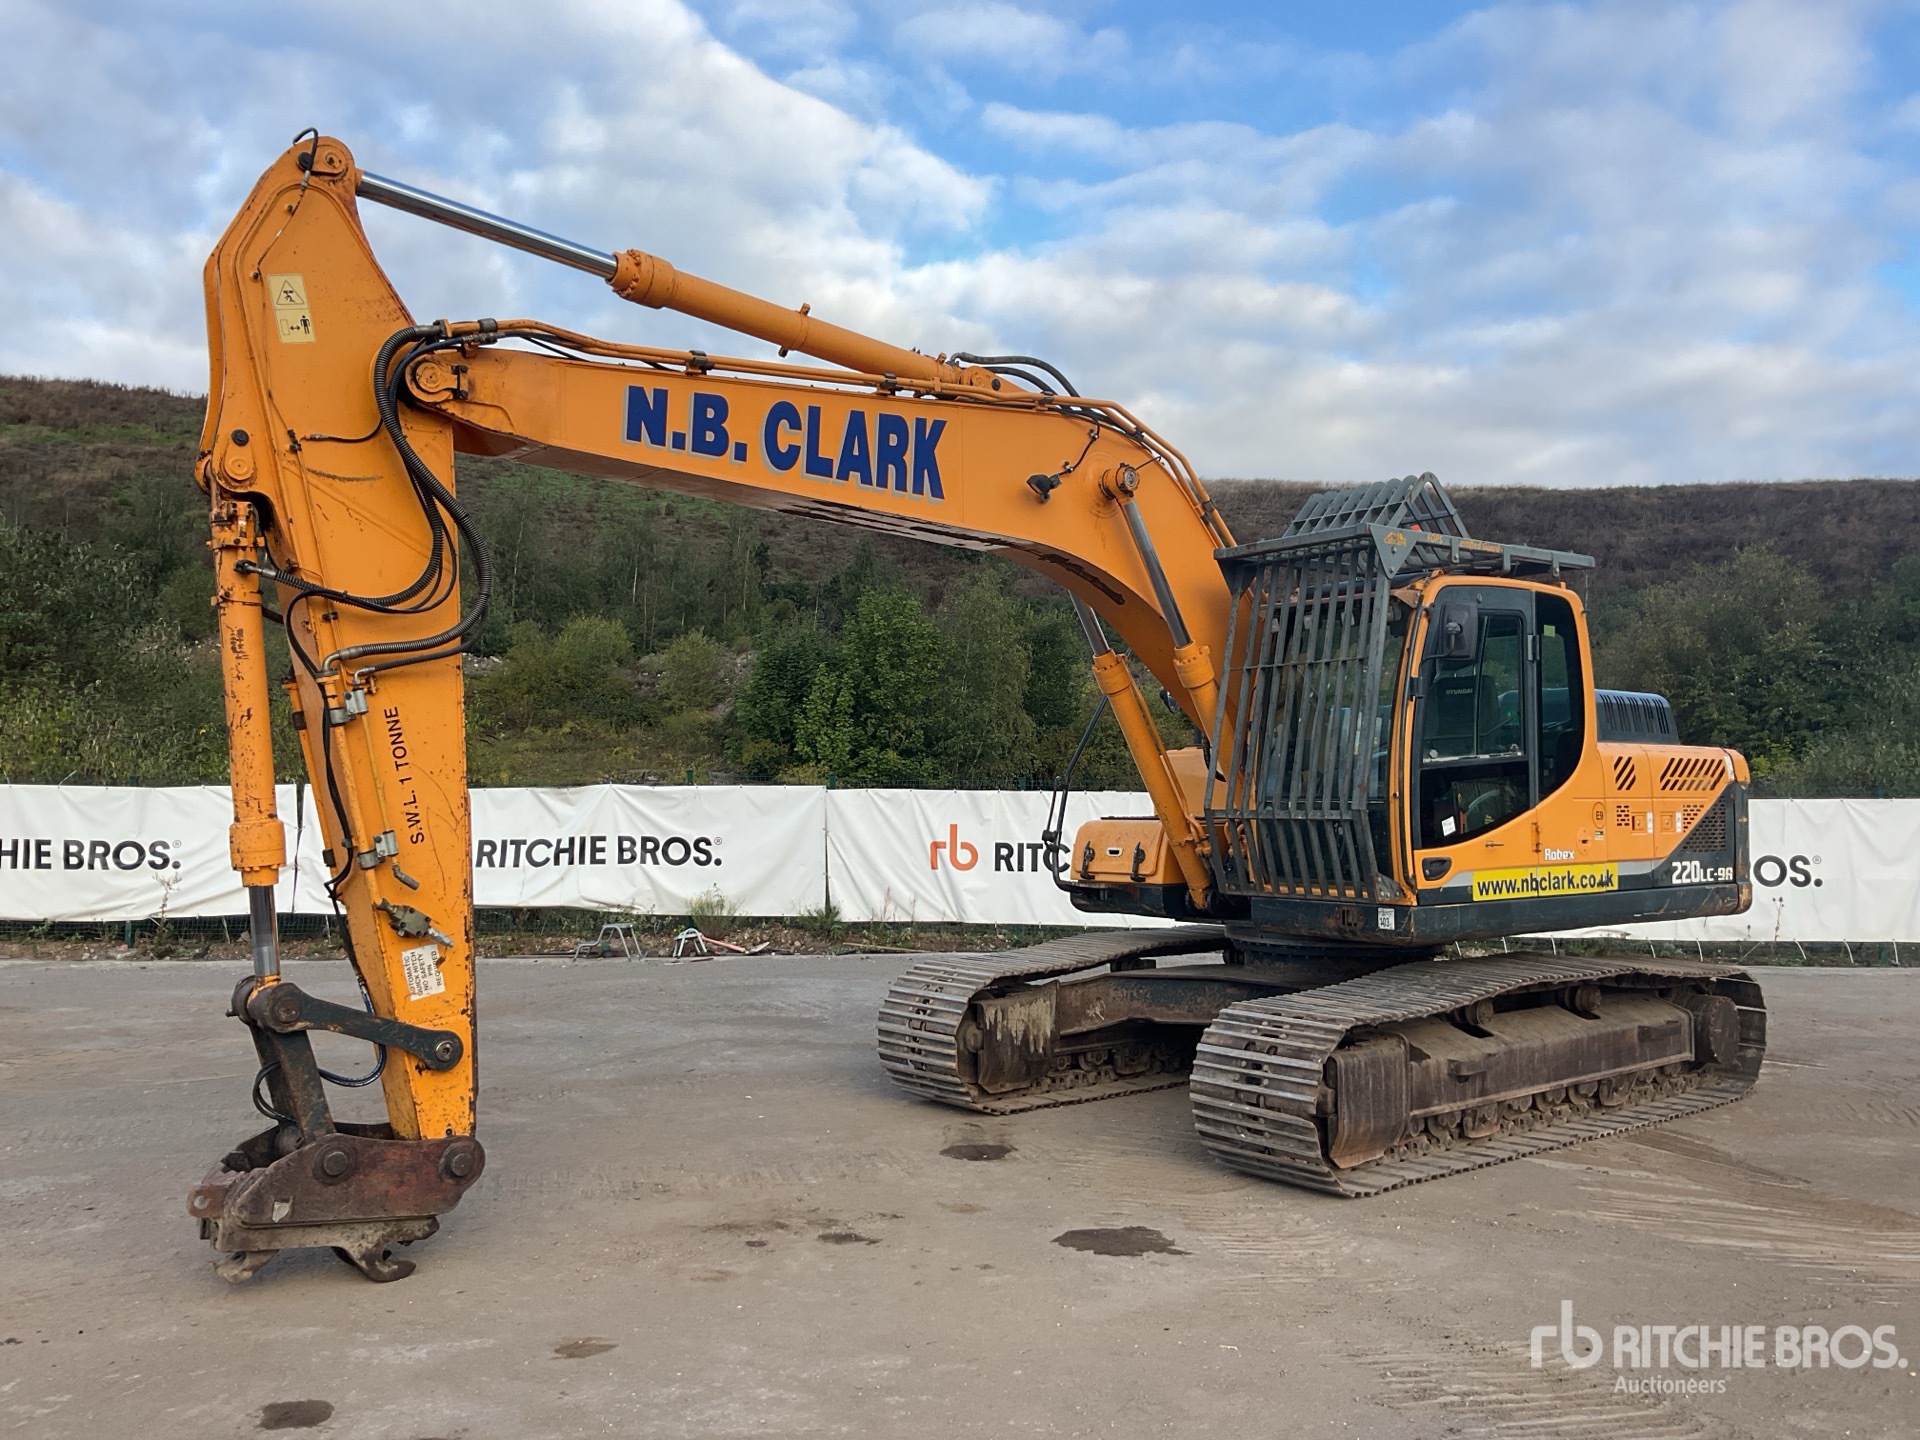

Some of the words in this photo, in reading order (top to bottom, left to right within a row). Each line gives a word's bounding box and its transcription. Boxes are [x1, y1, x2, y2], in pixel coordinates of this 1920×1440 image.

[623, 385, 748, 464] N.B.
[762, 400, 948, 503] CLARK
[384, 706, 409, 771] TONNE
[399, 777, 412, 785] 1
[403, 789, 425, 844] S.W.L.
[475, 835, 607, 868] RITCHIE
[1544, 848, 1575, 861] Robex
[1477, 868, 1614, 897] www.nbclark.co.uk
[404, 955, 416, 995] AUTOMATIC
[410, 951, 419, 973] HITCH
[417, 953, 428, 979] SAFETY
[414, 974, 424, 996] QUICK
[422, 980, 430, 991] NO
